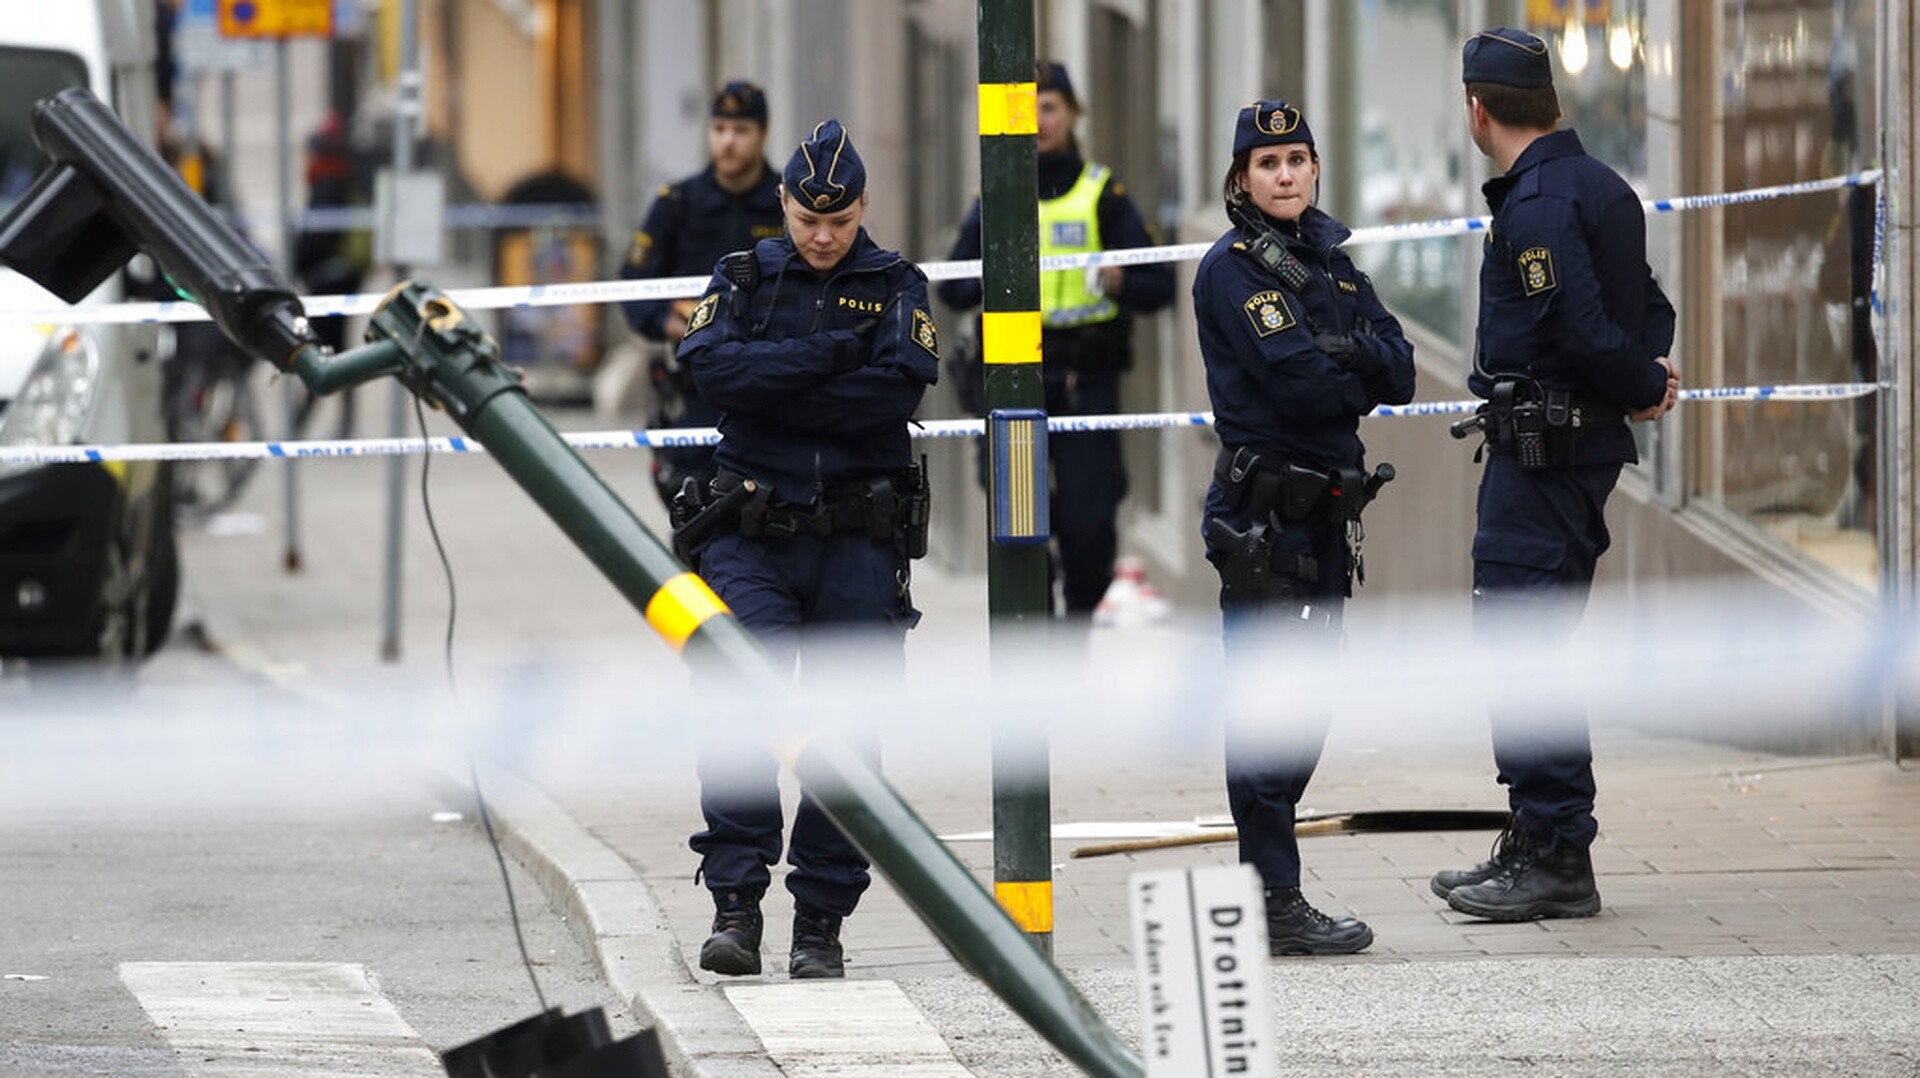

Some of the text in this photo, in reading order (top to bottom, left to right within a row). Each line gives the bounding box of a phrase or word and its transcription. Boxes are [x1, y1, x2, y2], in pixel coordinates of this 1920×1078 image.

[1520, 250, 1547, 266] POLIS
[838, 296, 883, 313] POLIS
[1247, 292, 1279, 311] POLIS
[1209, 906, 1257, 1074] Drottnin
